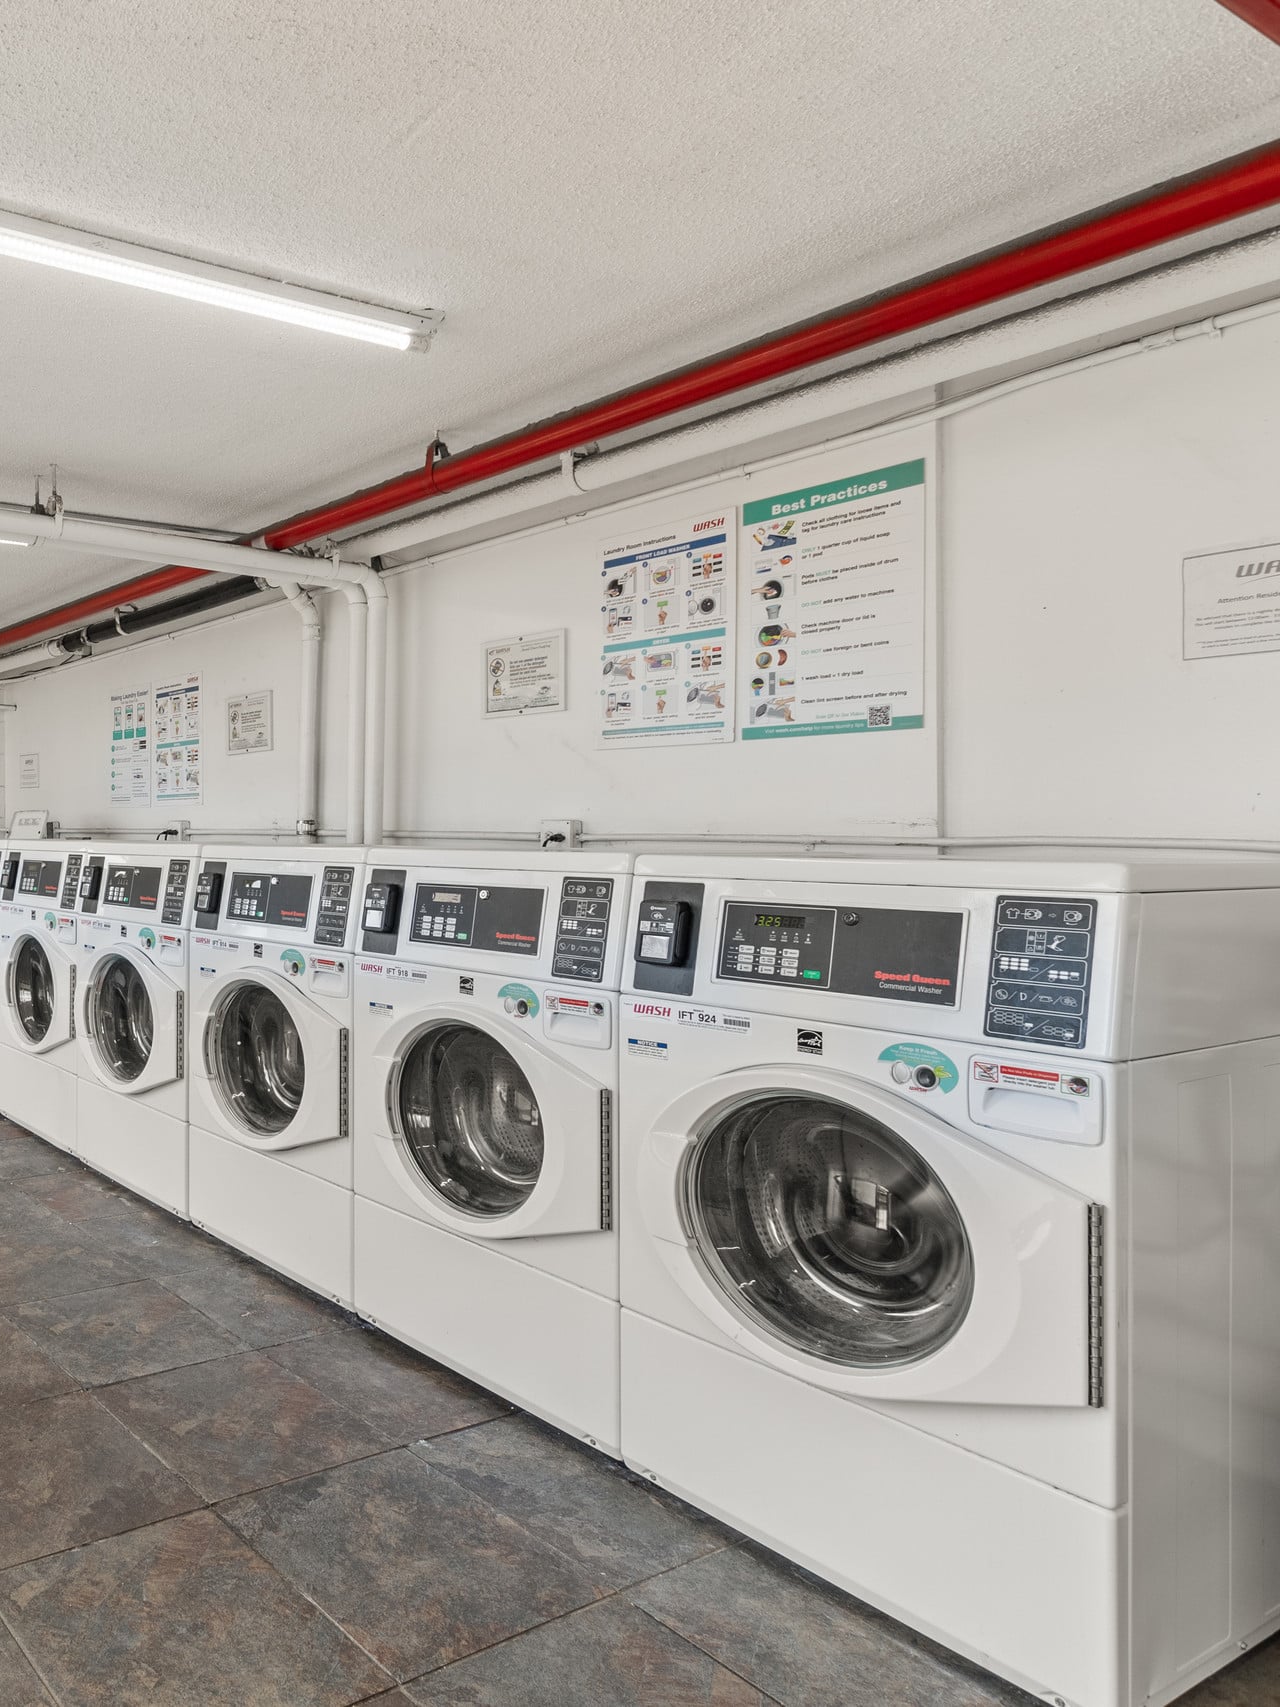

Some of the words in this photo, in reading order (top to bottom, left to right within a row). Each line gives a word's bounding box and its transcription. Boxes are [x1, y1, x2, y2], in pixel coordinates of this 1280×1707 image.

[771, 498, 806, 516] Best
[809, 480, 888, 507] Practices
[801, 519, 818, 527] Check
[826, 513, 847, 522] clothing
[873, 503, 889, 511] items
[819, 521, 839, 530] laundry
[853, 511, 886, 522] instructions
[693, 517, 725, 532] WASH
[603, 546, 625, 556] Laundry
[626, 542, 642, 550] Room
[643, 535, 676, 546] Instructions
[821, 541, 840, 550] quarter
[859, 533, 875, 542] liquid
[876, 531, 890, 540] soap
[839, 565, 858, 574] placed
[867, 589, 894, 597] machines
[1217, 595, 1255, 604] Attention
[818, 618, 840, 626] machine
[819, 625, 841, 633] properly
[834, 644, 852, 652] foreign
[888, 689, 907, 697] drying
[360, 962, 383, 973] WASH
[874, 970, 910, 982] Speed
[911, 974, 950, 986] Queen
[879, 981, 916, 992] Commercial
[918, 984, 943, 995] Washer
[633, 1003, 671, 1017] WASH
[678, 1010, 694, 1021] IFT
[698, 1013, 717, 1024] 924
